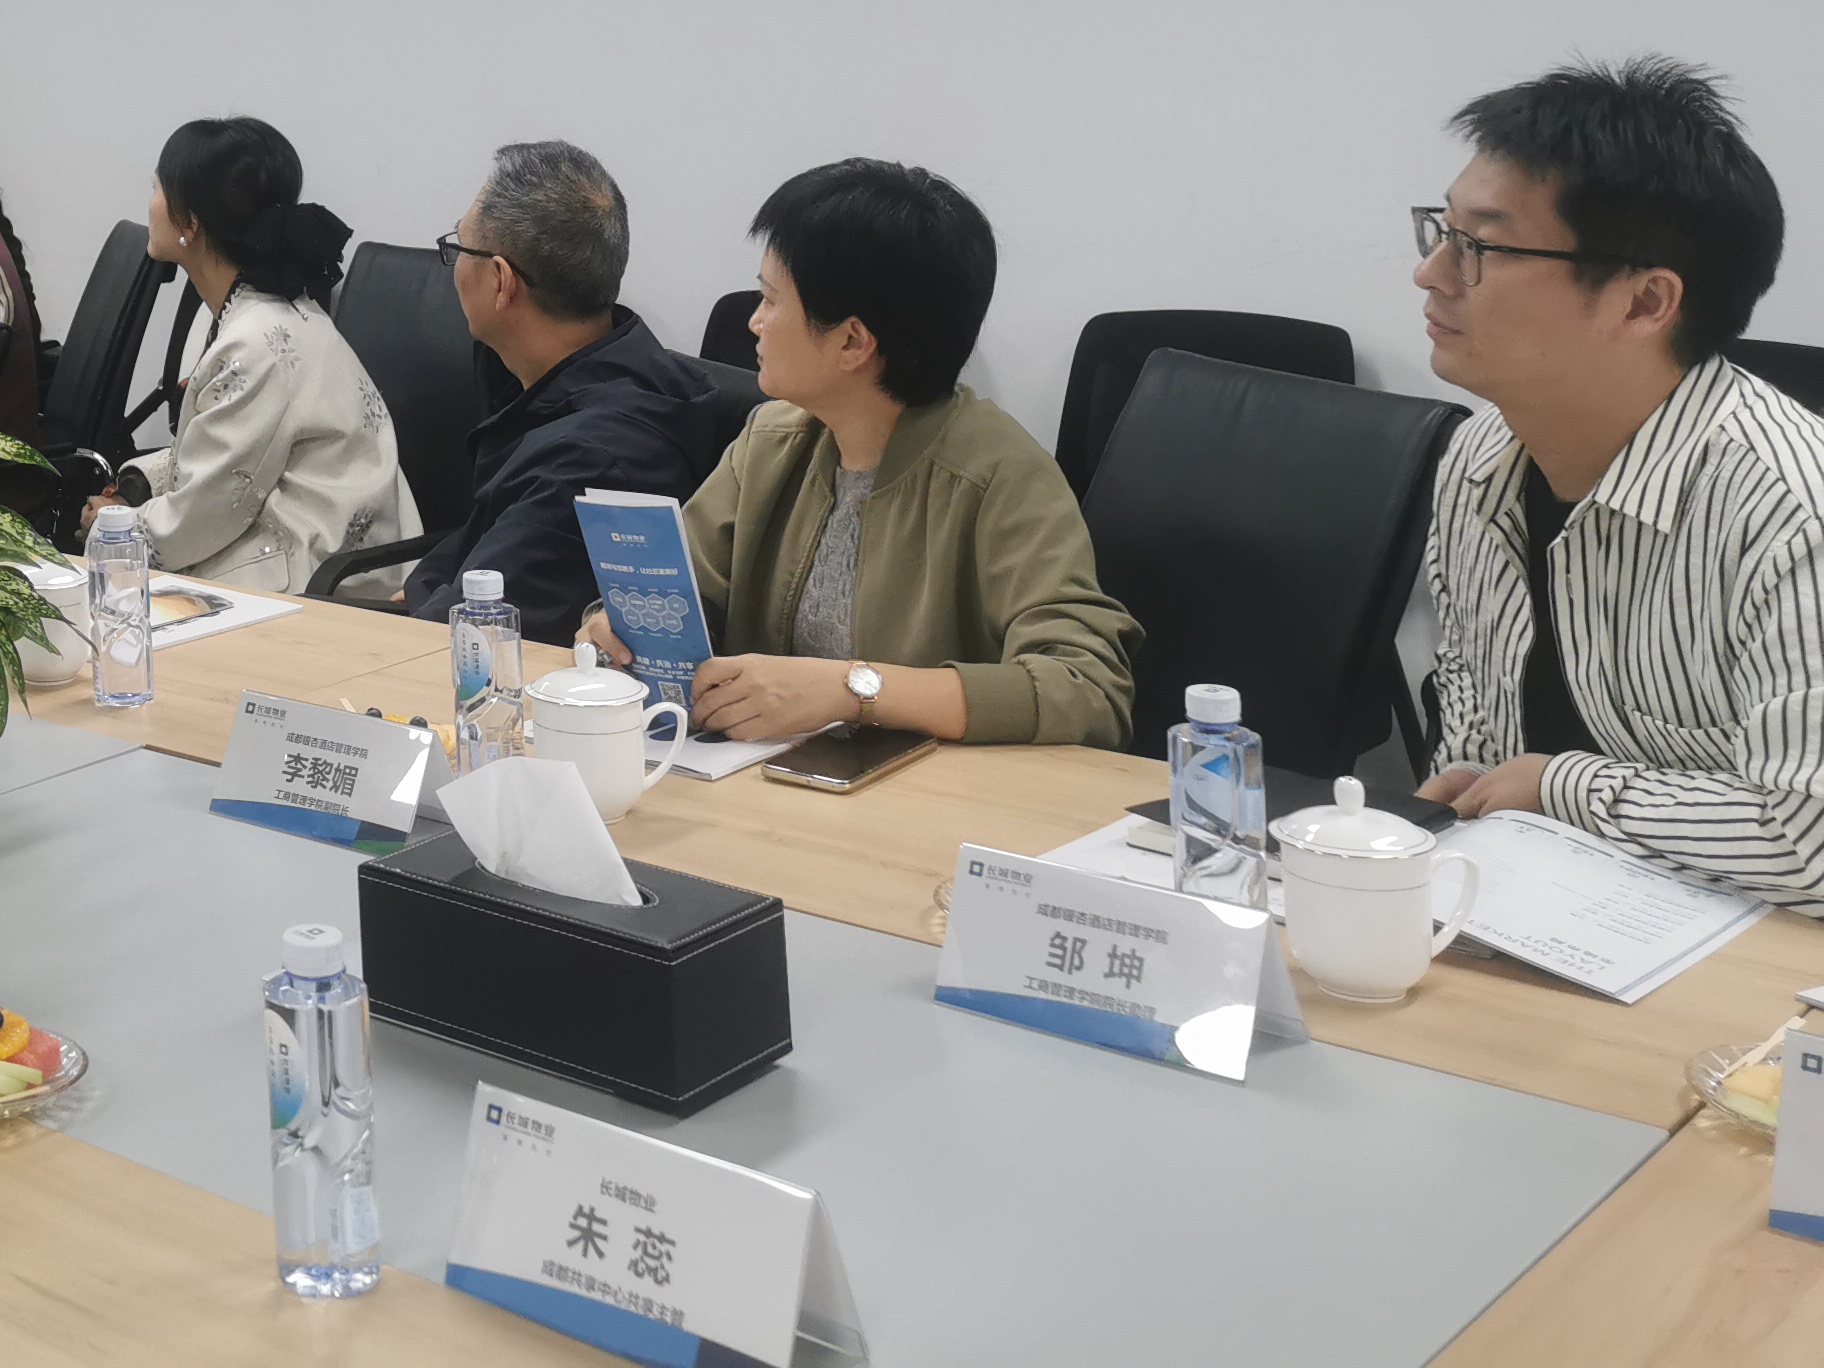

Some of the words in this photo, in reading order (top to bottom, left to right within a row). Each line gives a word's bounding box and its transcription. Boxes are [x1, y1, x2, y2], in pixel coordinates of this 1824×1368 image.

[281, 752, 359, 798] 李黎媚
[1045, 930, 1146, 990] 邹坤
[599, 1176, 656, 1213] 长城物业
[565, 1202, 676, 1287] 朱蕊
